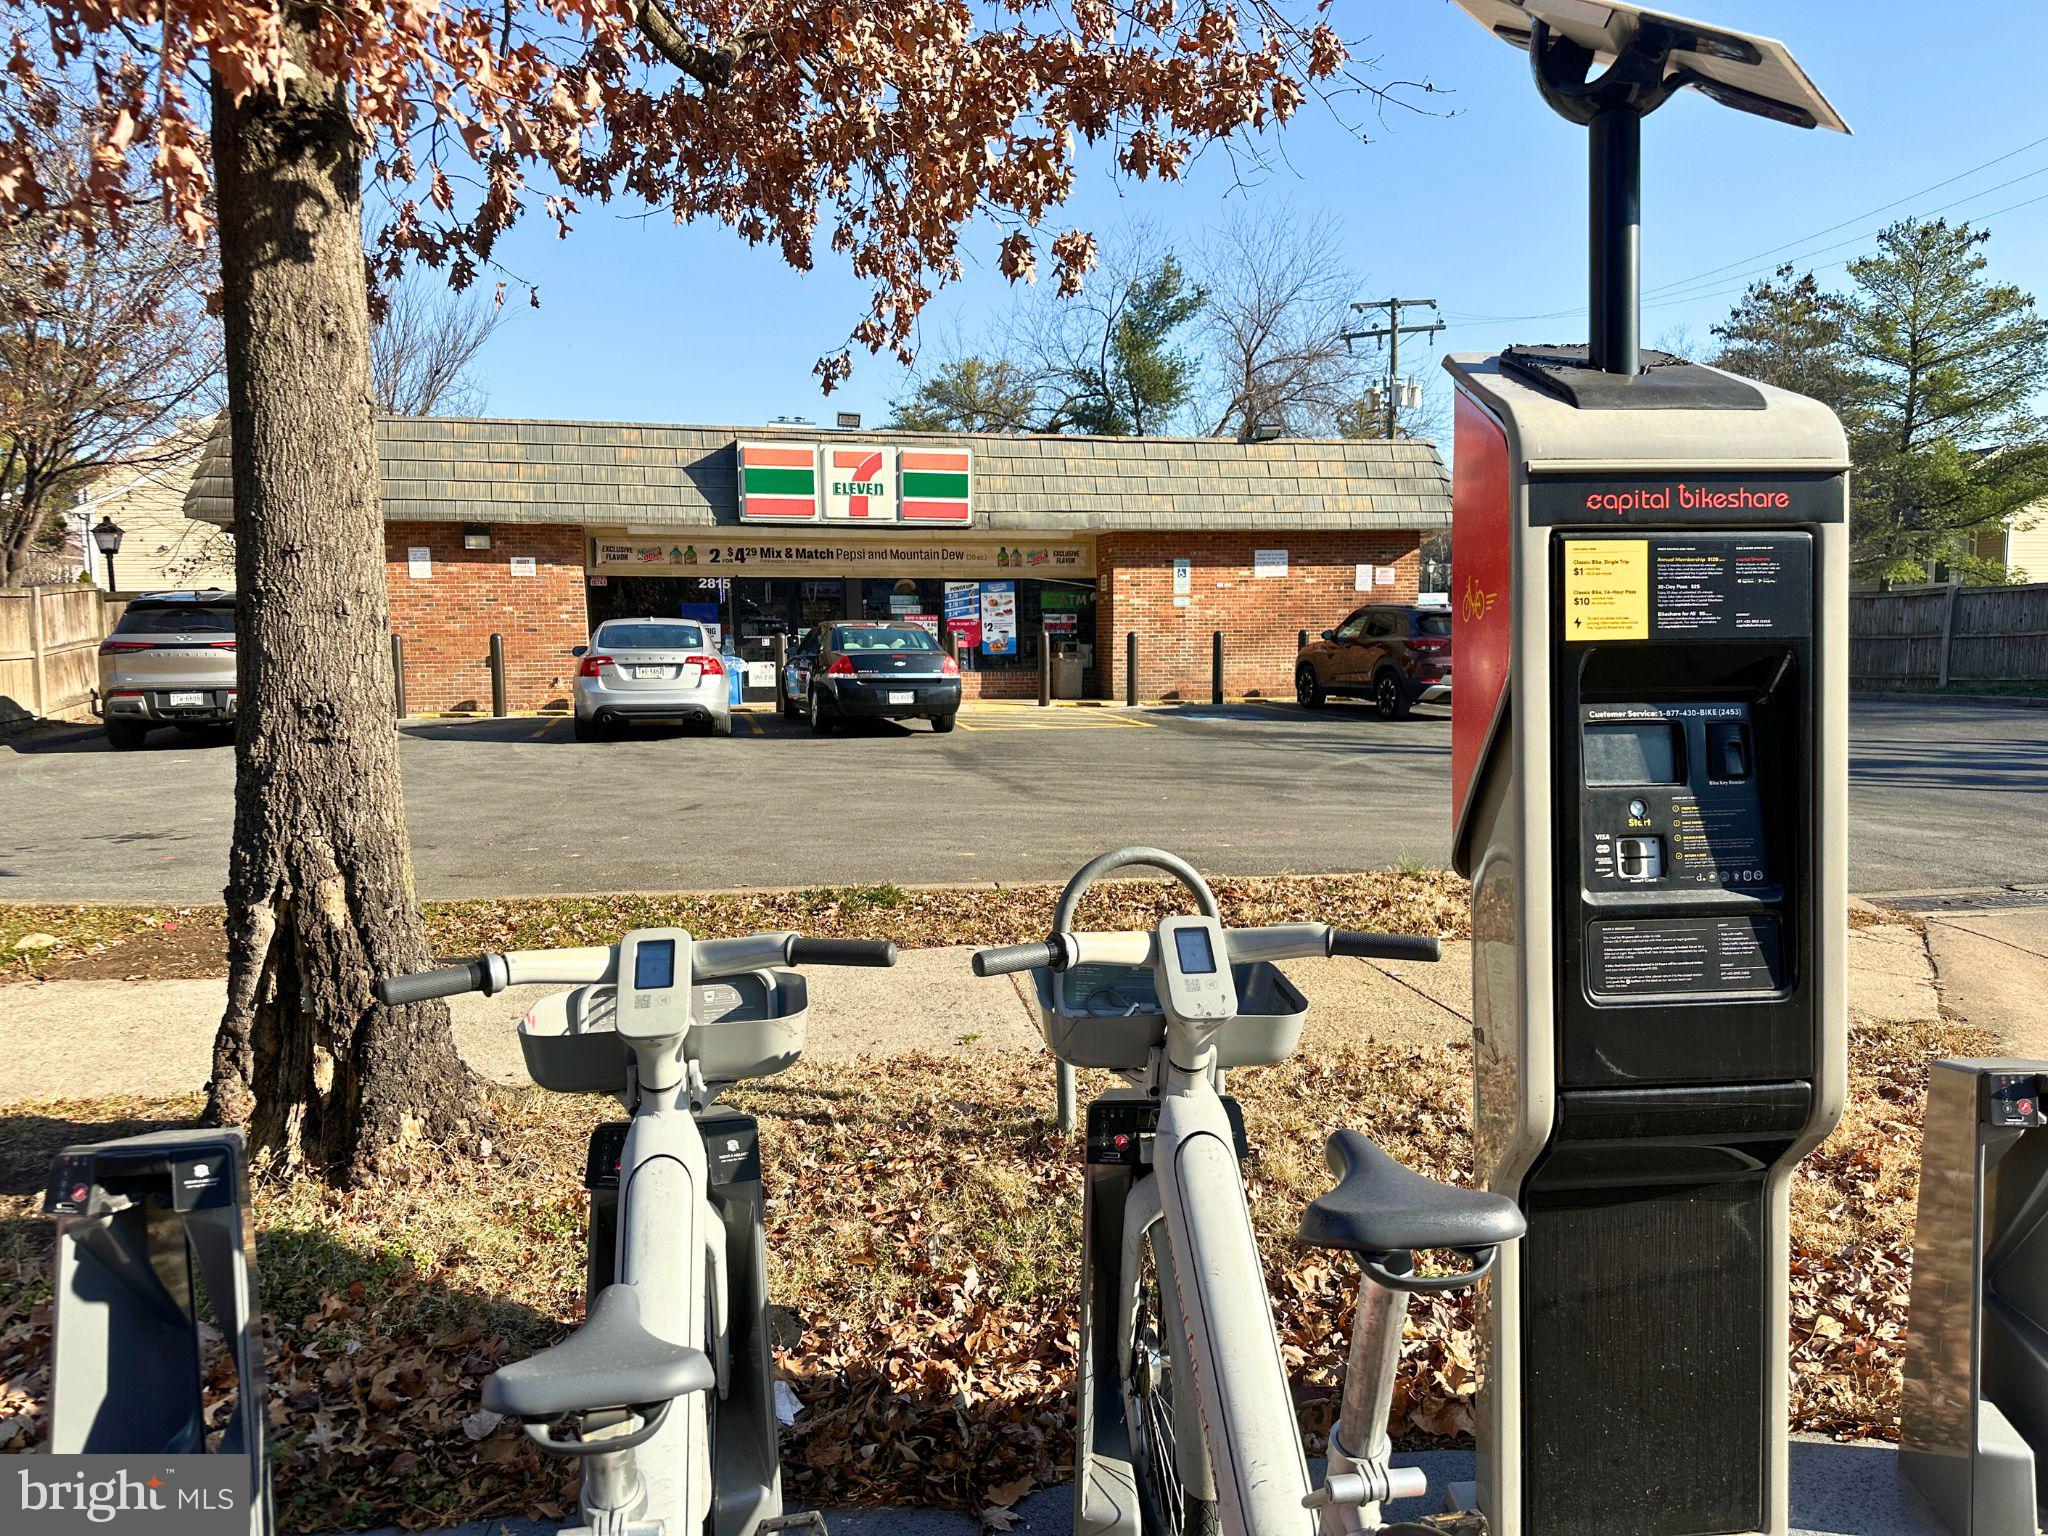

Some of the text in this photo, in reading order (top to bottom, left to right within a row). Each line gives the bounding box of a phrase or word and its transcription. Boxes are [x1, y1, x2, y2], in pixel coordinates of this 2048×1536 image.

[834, 451, 882, 516] 7
[1587, 483, 1790, 515] capital bikeshare
[601, 545, 633, 554] EXCLUSIVE
[605, 553, 629, 561] FLAVOR
[709, 548, 721, 564] 2
[760, 547, 782, 559] Mix
[784, 548, 793, 559] &
[795, 547, 834, 560] Match
[836, 548, 866, 562] Pepsi
[868, 549, 887, 560] and
[890, 549, 940, 560] Mountain
[942, 549, 965, 560] Dew
[1573, 567, 1584, 576] $1
[699, 578, 731, 590] 2815
[1573, 597, 1590, 606] $10
[984, 622, 993, 632] $2
[1589, 708, 1742, 719] Customer Service: 1-877-430-BIKE (2453)
[1628, 818, 1652, 827] Start
